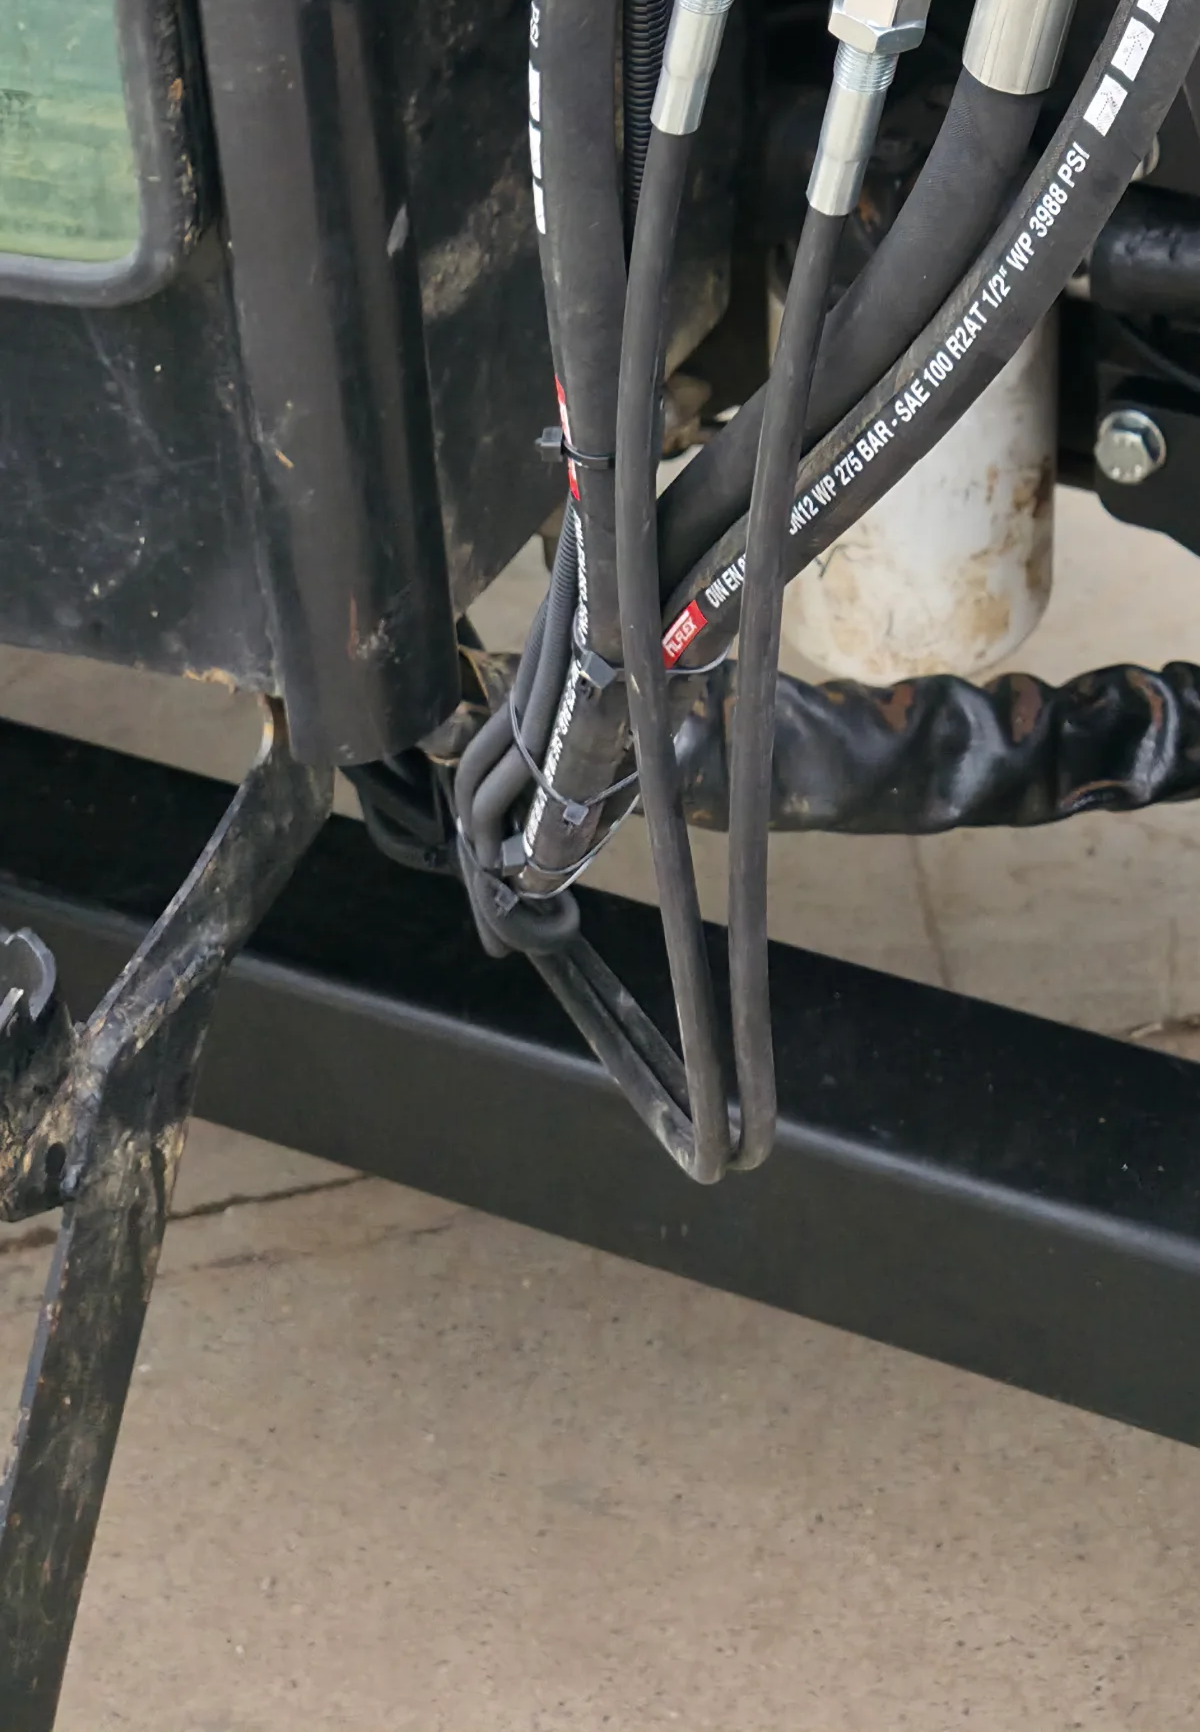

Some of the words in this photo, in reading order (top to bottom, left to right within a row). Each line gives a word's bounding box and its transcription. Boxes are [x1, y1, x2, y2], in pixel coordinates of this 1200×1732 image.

[529, 0, 541, 49] PSI
[705, 580, 729, 609] DIN
[723, 565, 746, 591] EN
[811, 474, 837, 506] WP
[834, 450, 864, 486] 275
[856, 420, 895, 463] BAR
[894, 378, 930, 423] SAE
[923, 350, 954, 387] 100
[945, 301, 988, 360] R2AT
[1005, 232, 1035, 272] WP
[1029, 182, 1068, 238] 3988
[1057, 141, 1091, 188] PSI
